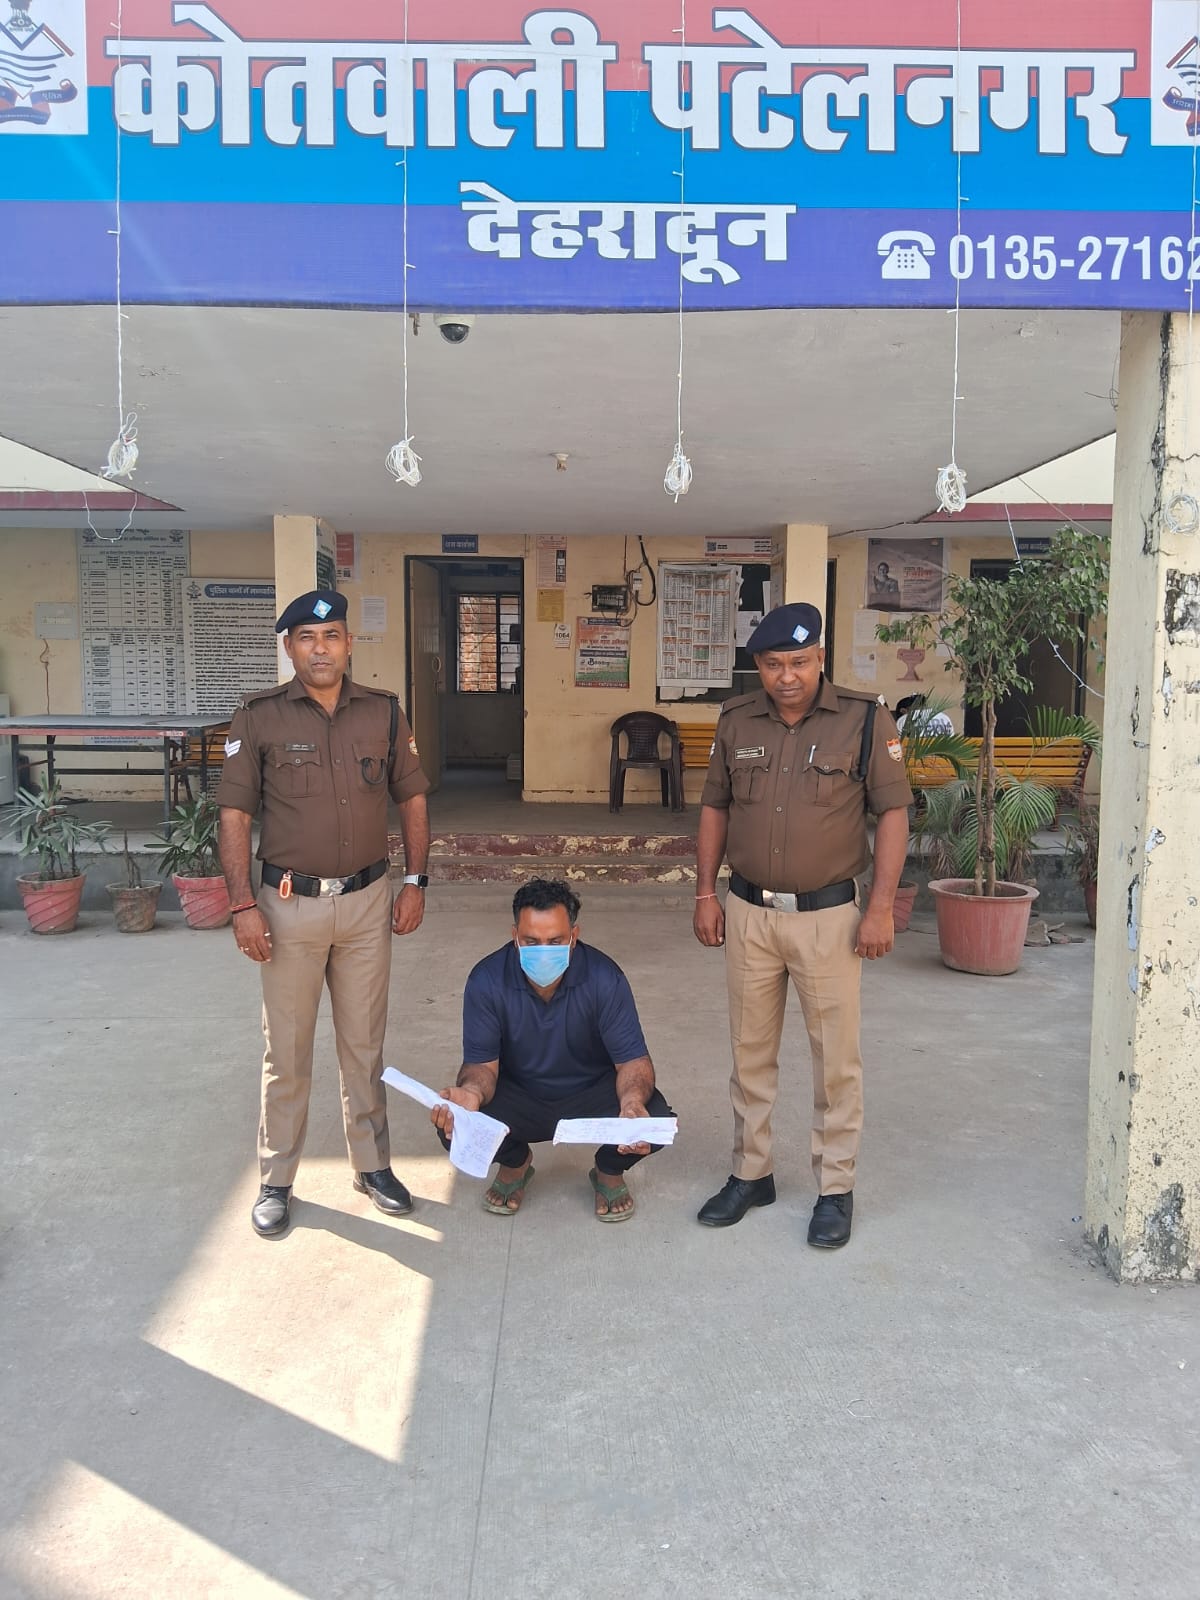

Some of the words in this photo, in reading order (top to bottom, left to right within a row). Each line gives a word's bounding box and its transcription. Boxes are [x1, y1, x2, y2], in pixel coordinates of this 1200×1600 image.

[105, 1, 617, 149] कोतवाली
[643, 8, 1137, 156] पटेलनगर
[460, 180, 797, 285] देहरादून
